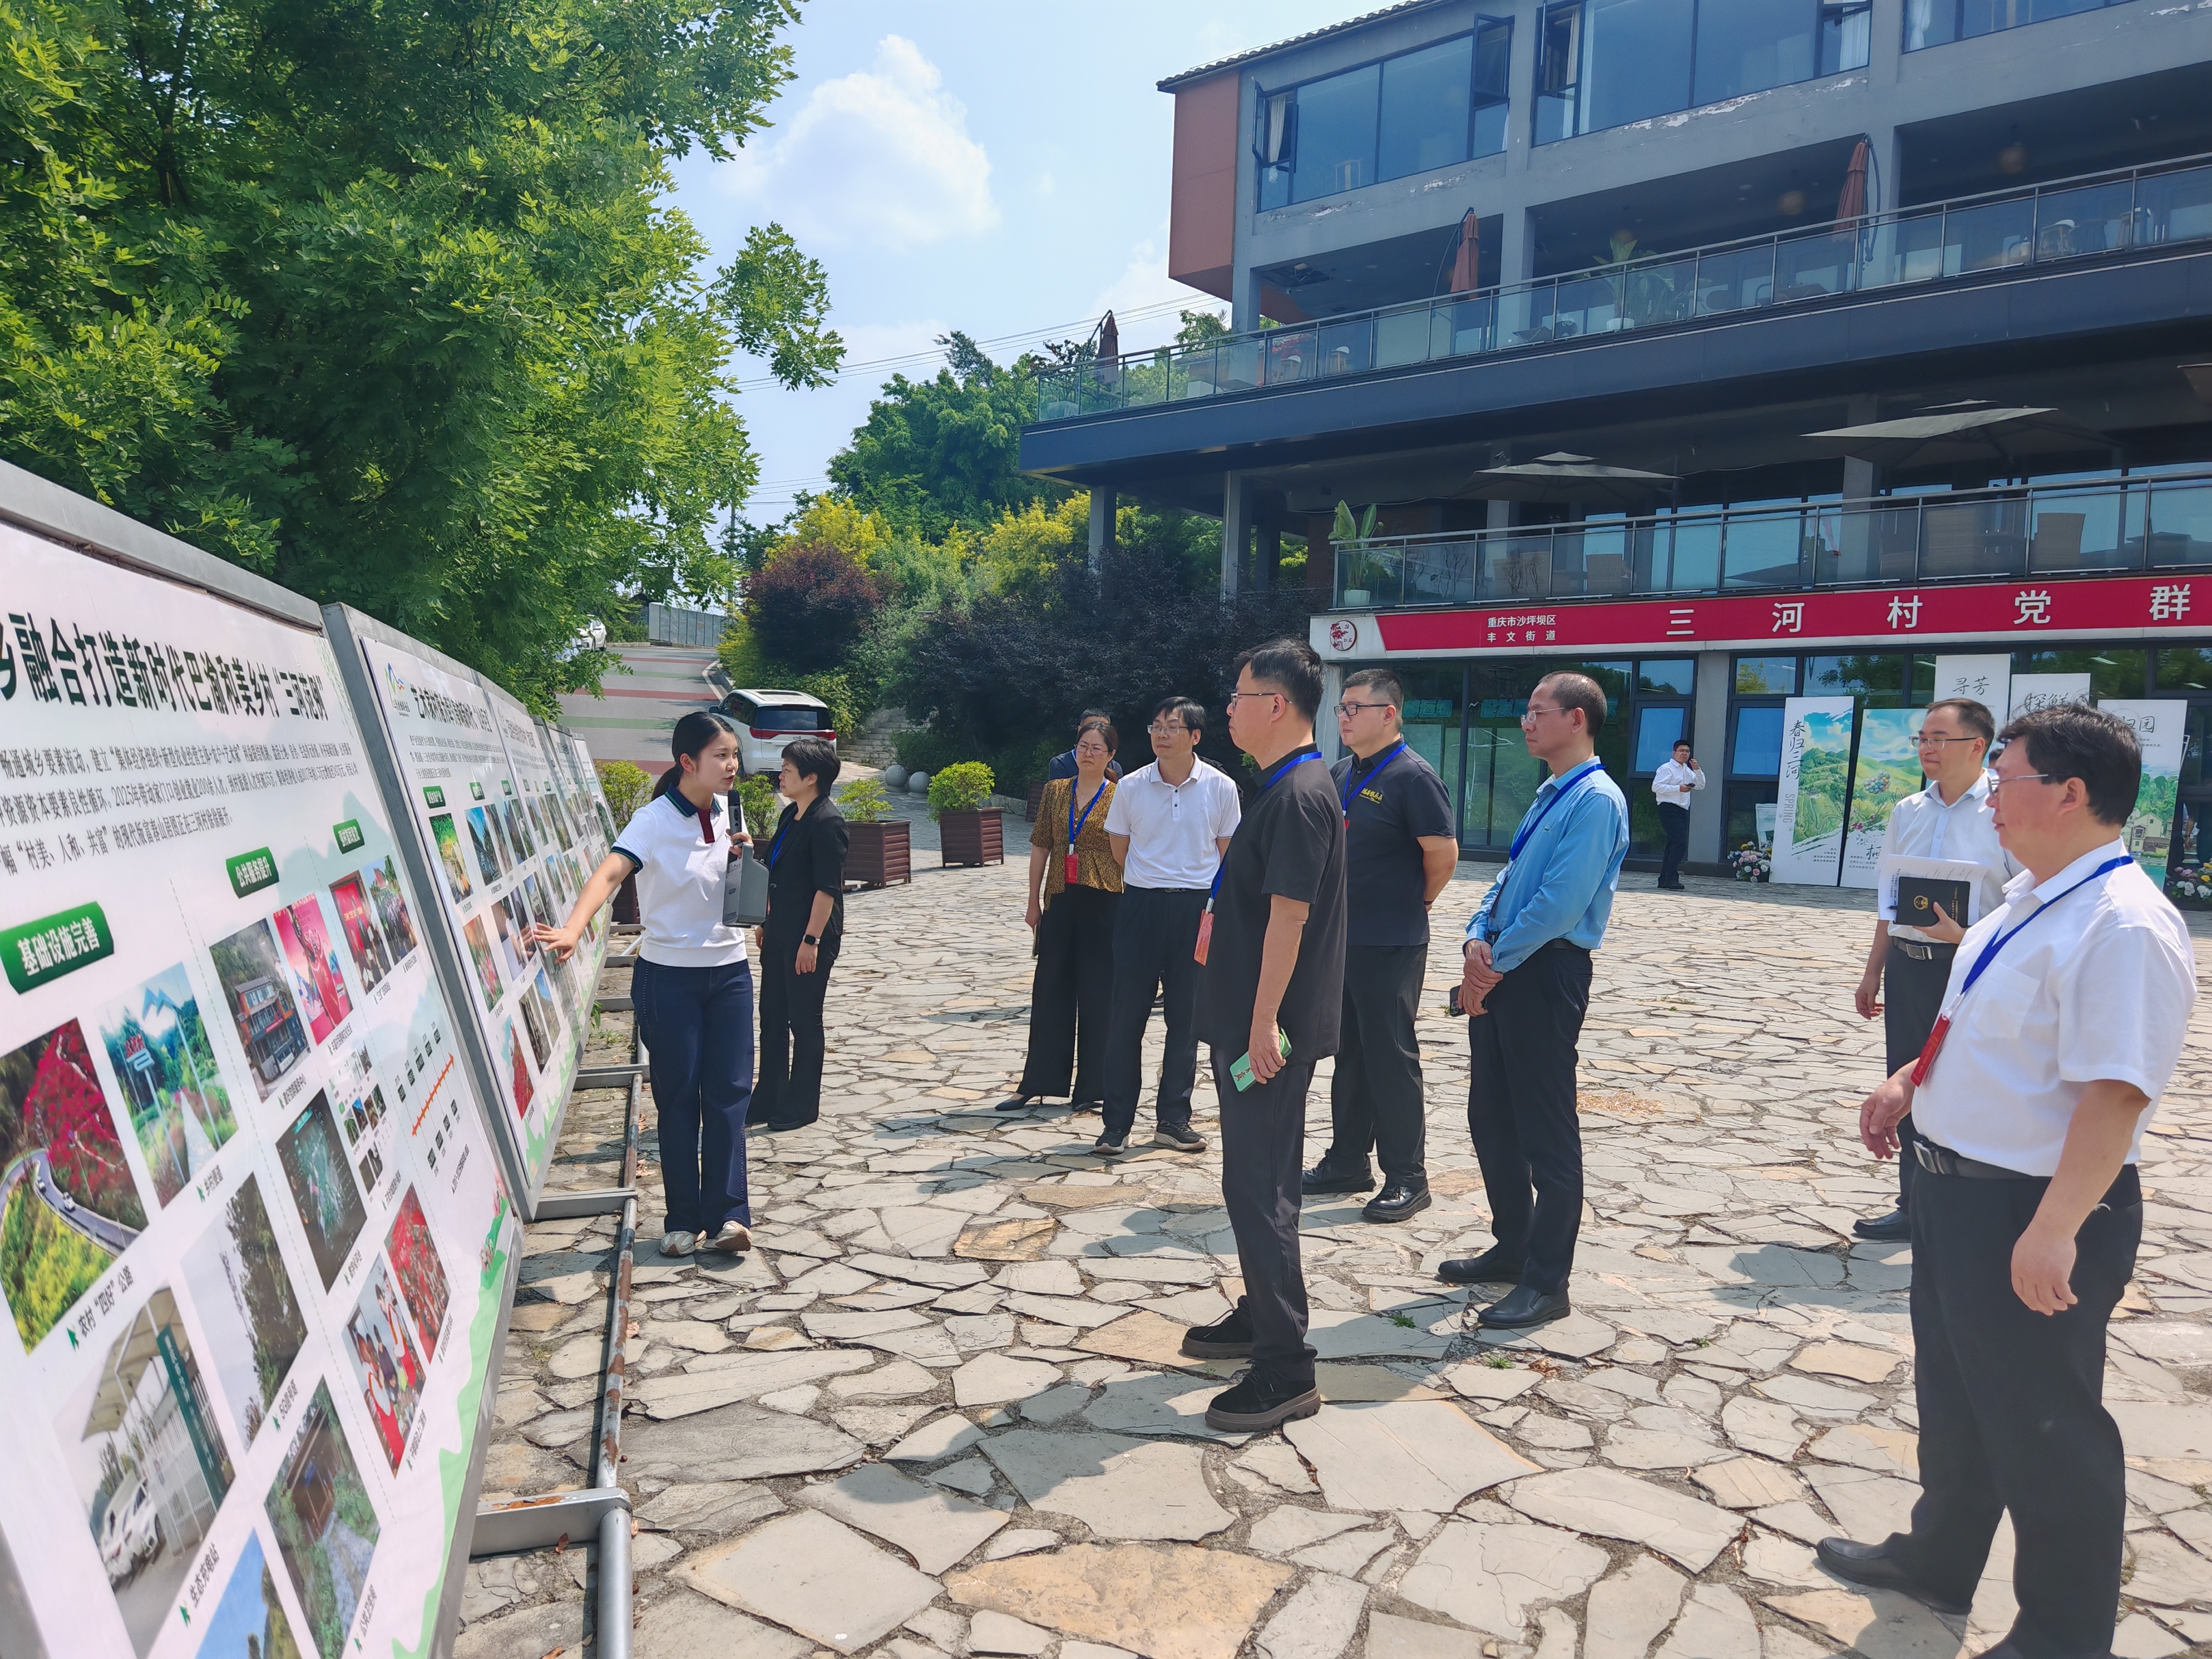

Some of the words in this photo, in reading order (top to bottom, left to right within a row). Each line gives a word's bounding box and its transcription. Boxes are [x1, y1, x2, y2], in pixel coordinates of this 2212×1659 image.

[1487, 614, 1556, 628] 重庆市沙坪坝区
[1487, 630, 1556, 643] 丰文街道
[1786, 720, 1806, 780] 春归三河
[1783, 793, 1795, 824] SPRING
[235, 856, 272, 888] 公共服务提升
[18, 916, 100, 976] 基础设施完善
